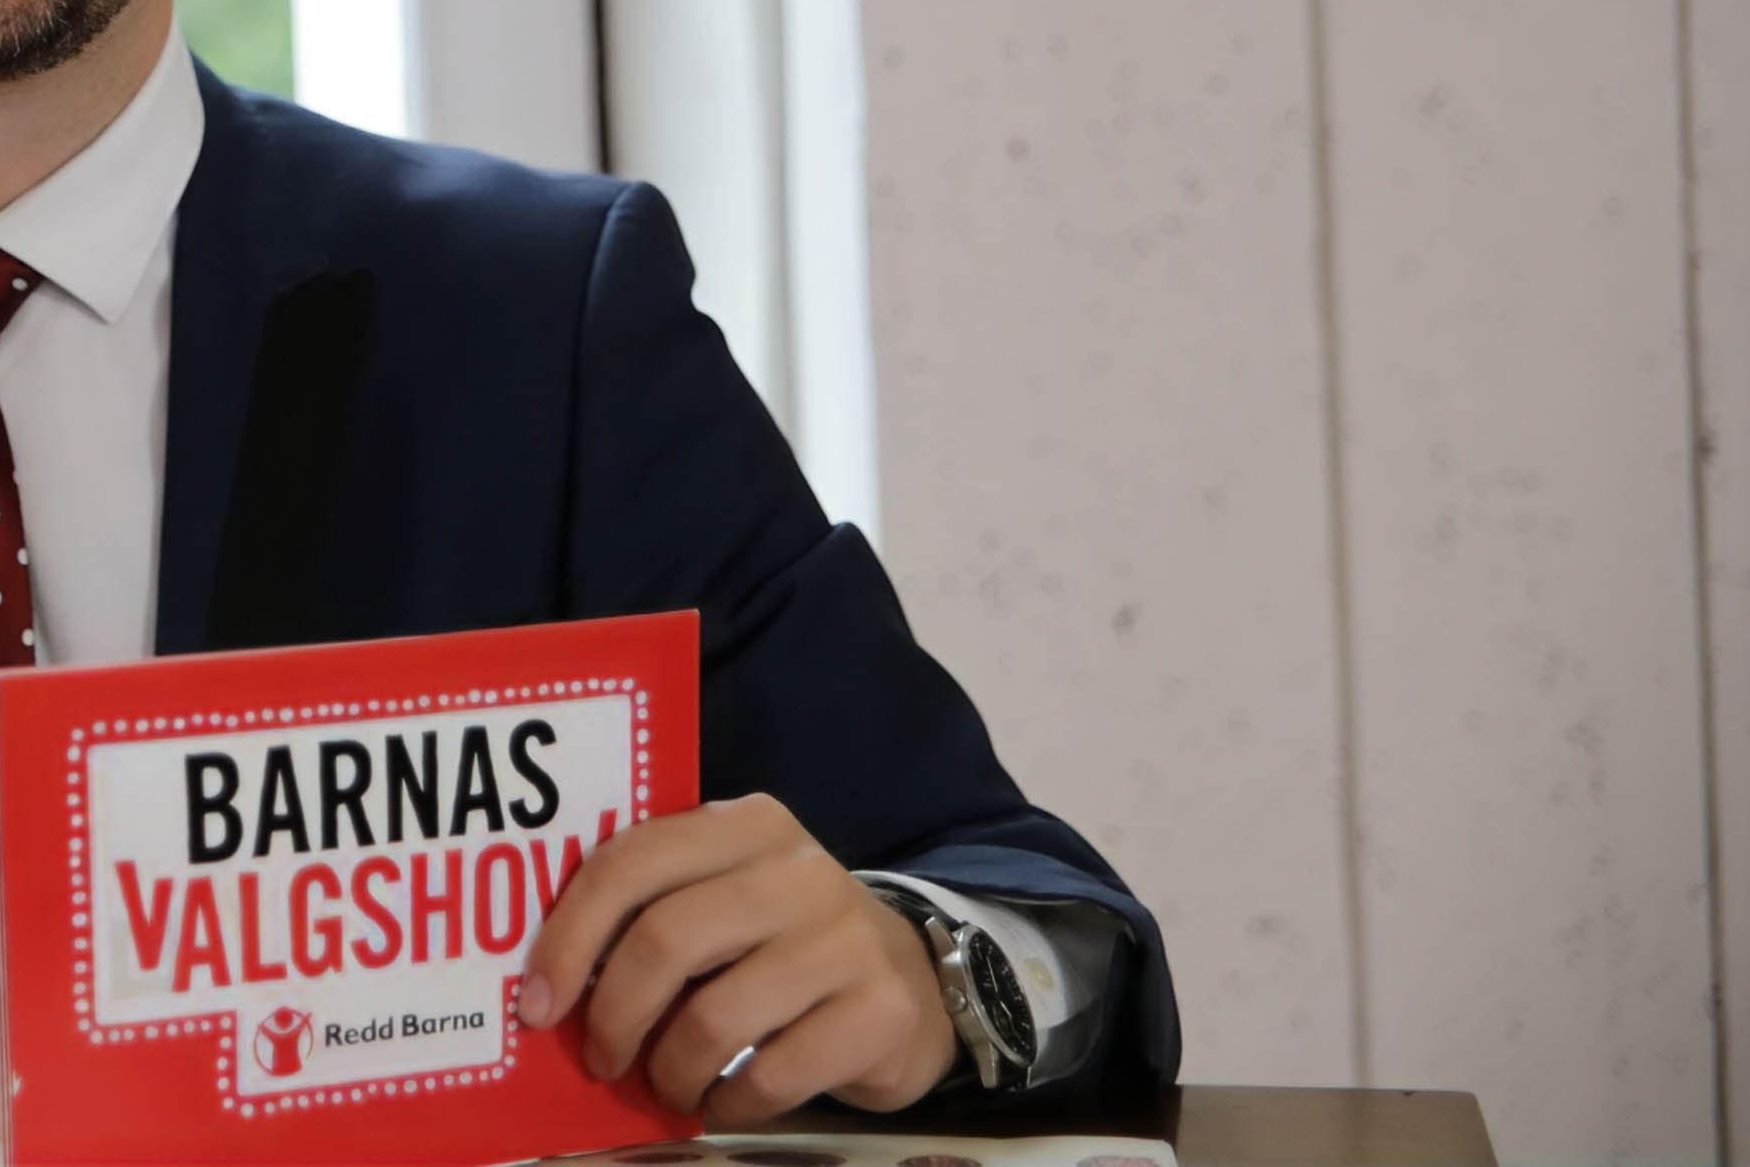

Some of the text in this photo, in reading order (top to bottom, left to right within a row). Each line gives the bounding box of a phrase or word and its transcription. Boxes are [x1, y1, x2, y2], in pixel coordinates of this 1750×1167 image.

[184, 719, 561, 864] BARNAS
[324, 1010, 485, 1048] Redd Barna
